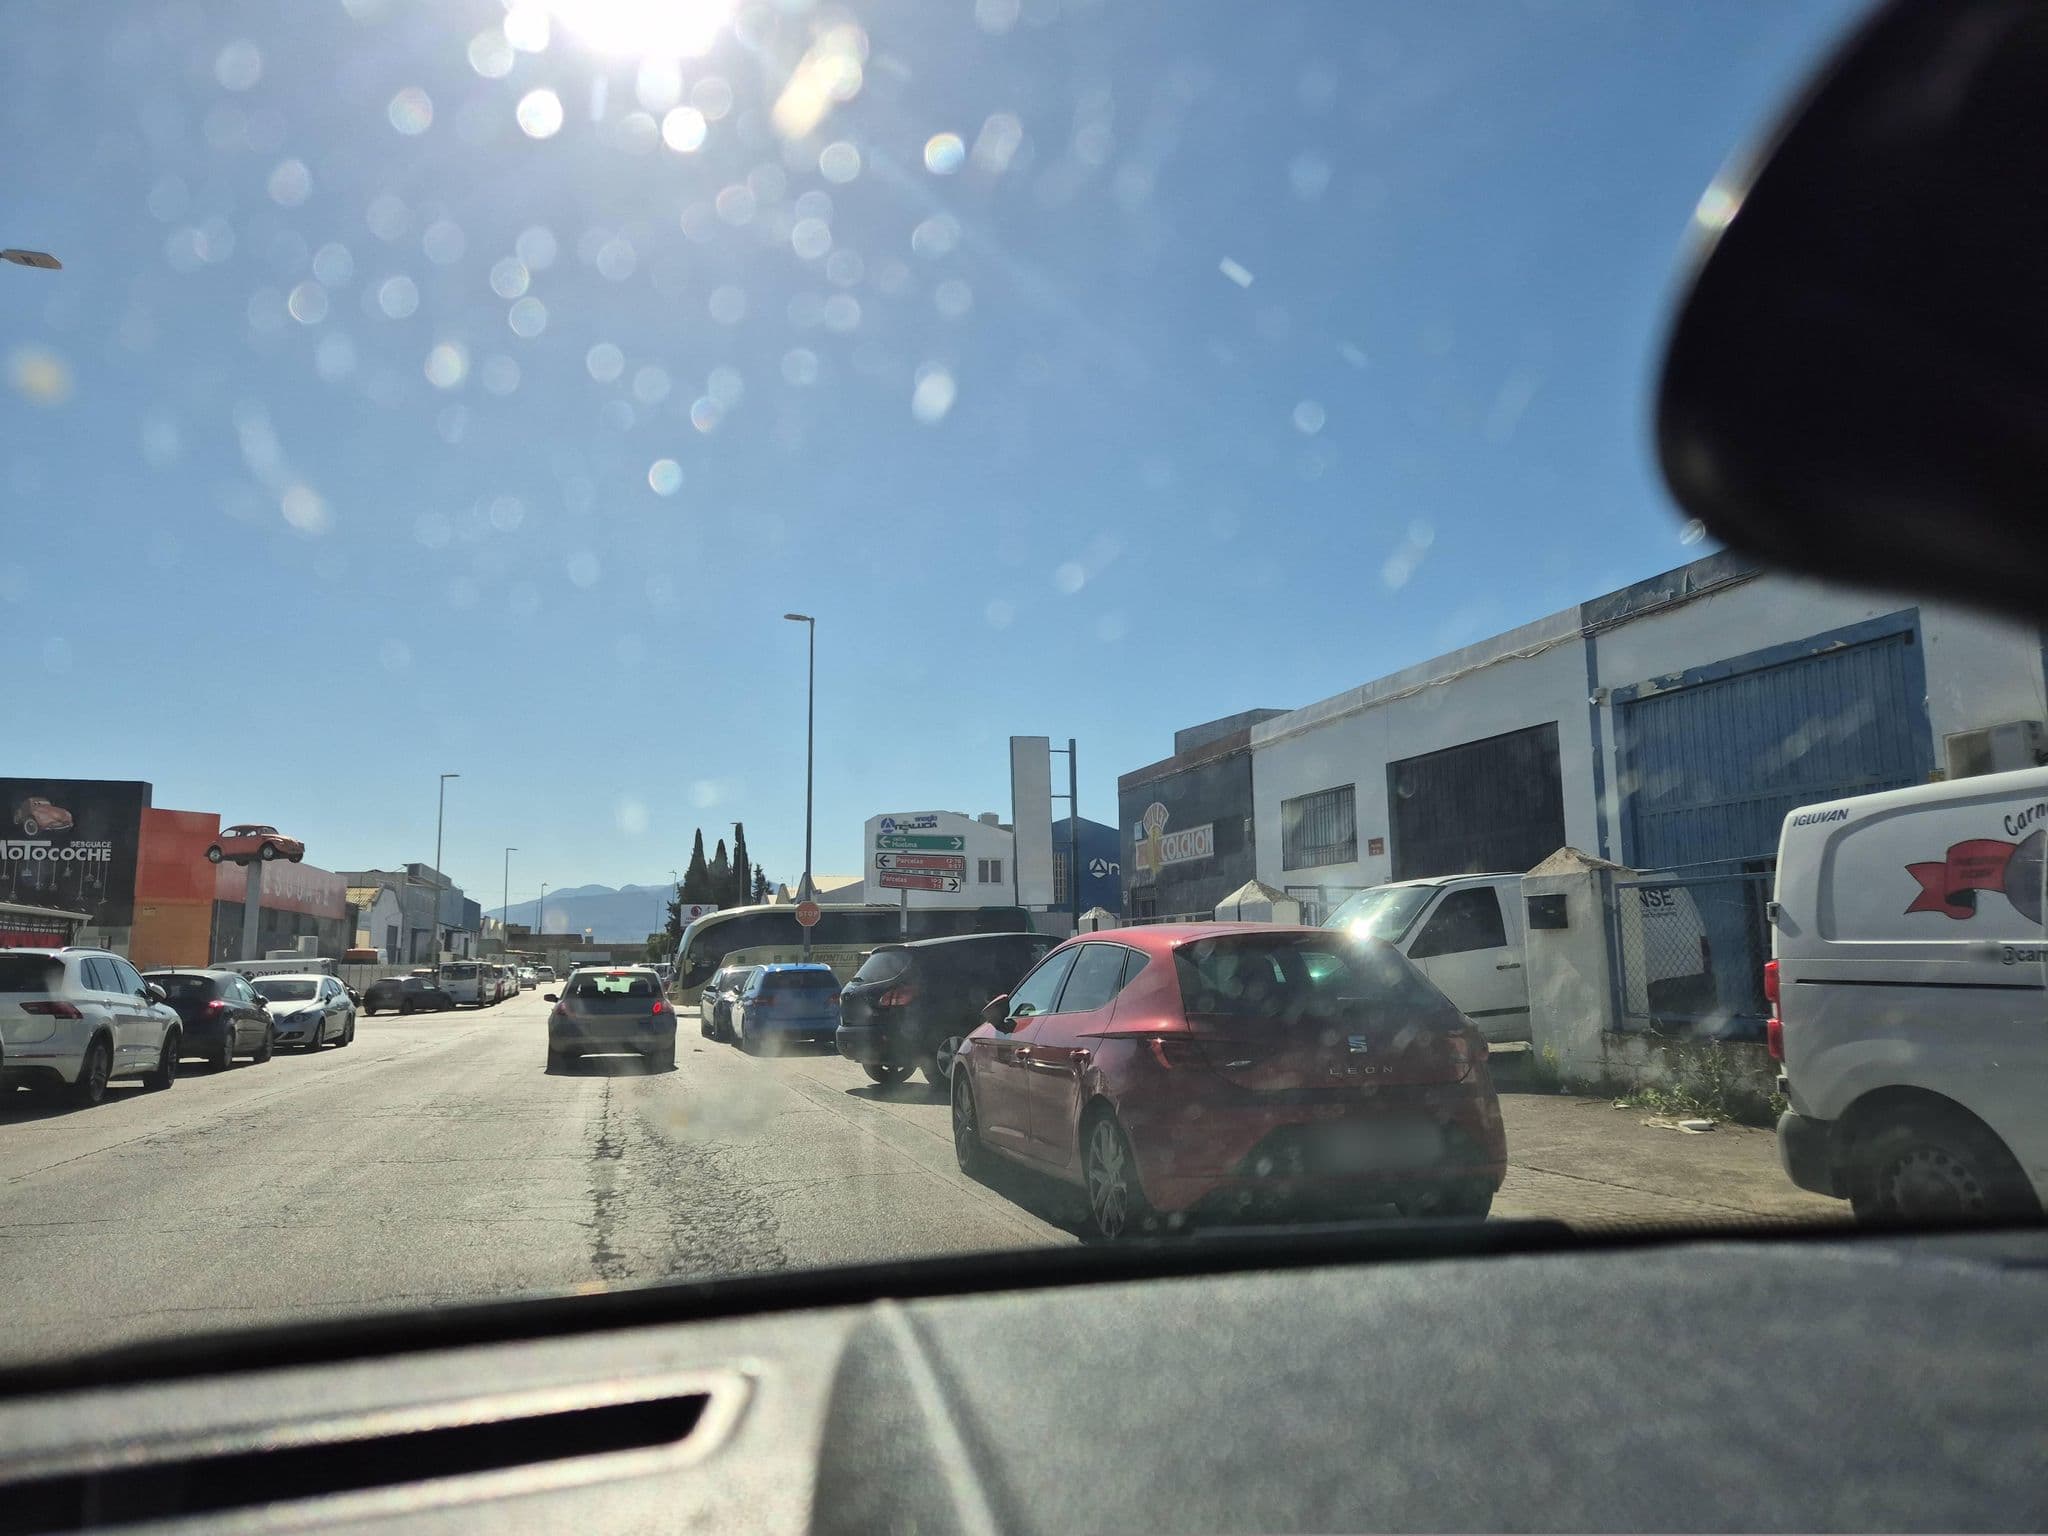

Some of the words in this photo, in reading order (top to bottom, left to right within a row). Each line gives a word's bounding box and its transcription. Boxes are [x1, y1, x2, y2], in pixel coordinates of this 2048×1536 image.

[1793, 808, 1849, 827] IGLUVAN
[70, 841, 112, 850] DESGUACE
[1161, 829, 1214, 862] COLCHON
[882, 874, 908, 883] Parcelas
[798, 910, 819, 919] STOP
[1329, 1066, 1393, 1075] LEON
